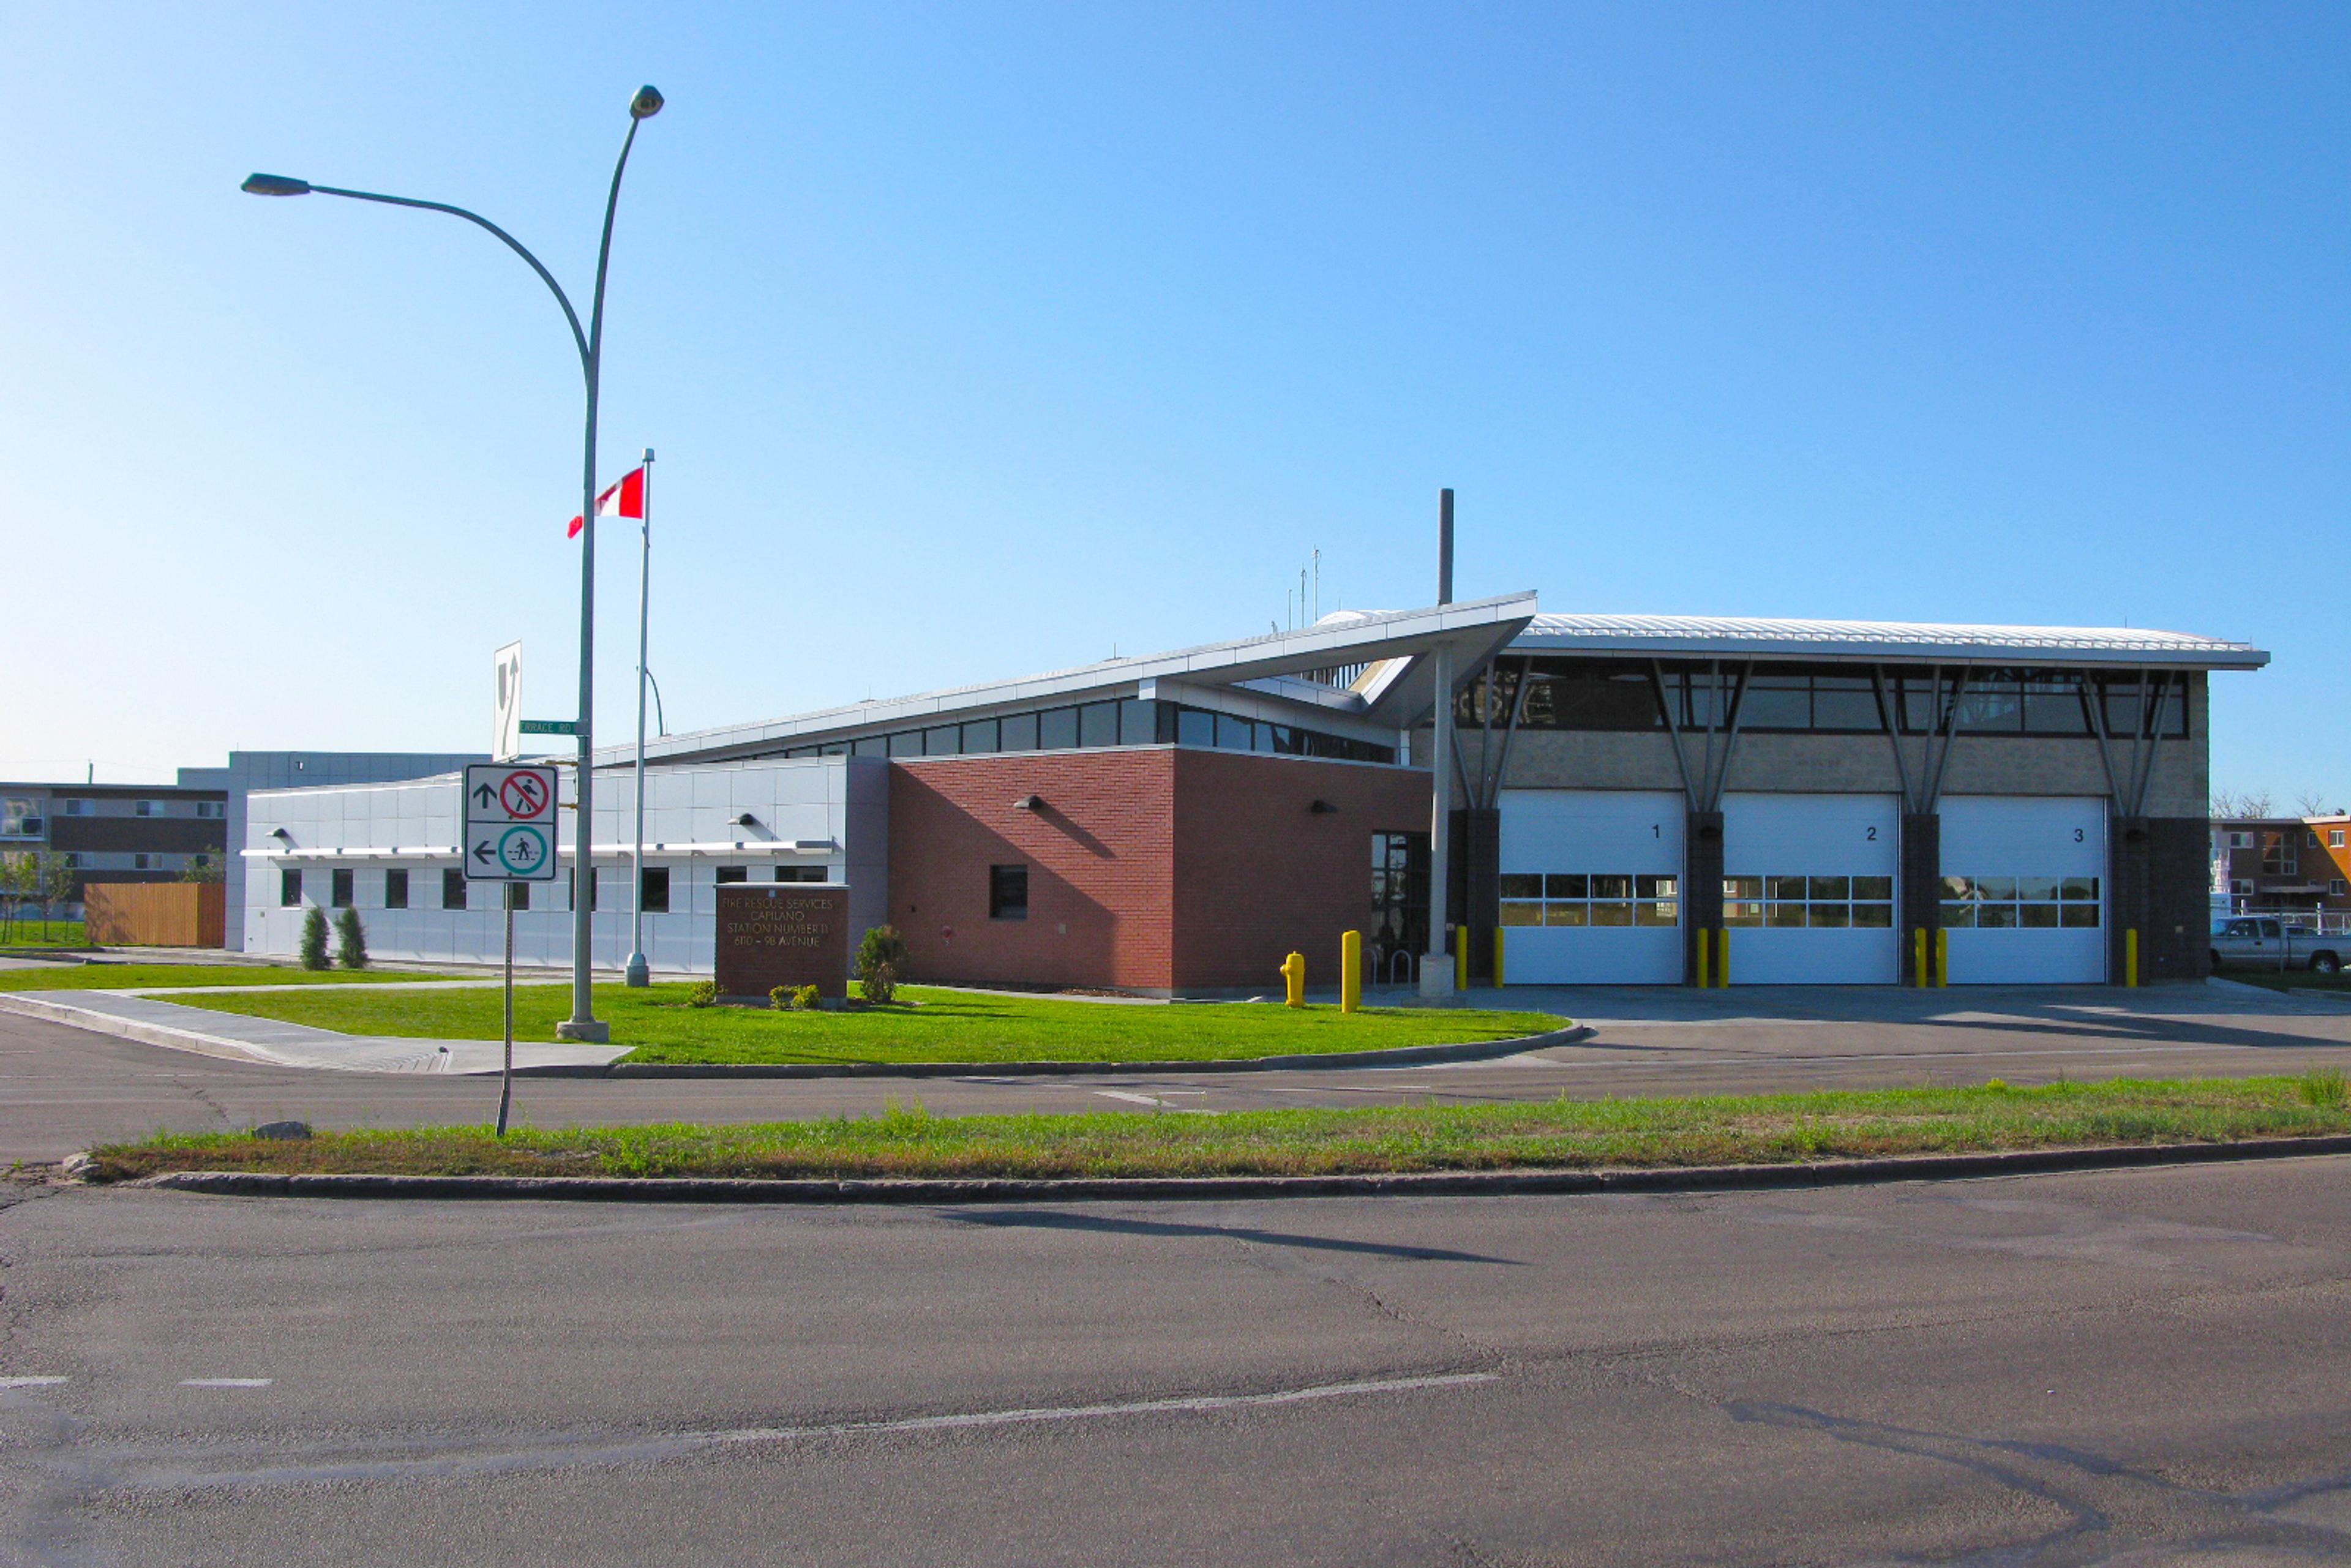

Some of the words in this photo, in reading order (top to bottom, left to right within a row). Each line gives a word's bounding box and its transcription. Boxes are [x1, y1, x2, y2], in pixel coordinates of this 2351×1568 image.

[520, 721, 553, 733] ERRACE
[558, 722, 571, 733] RD
[1652, 824, 1659, 838] 1
[1867, 827, 1877, 841] 2
[2074, 828, 2083, 842] 3
[722, 898, 741, 908] FIRE
[744, 898, 784, 909] RESCUE
[786, 899, 833, 910] SERVICES
[751, 911, 805, 921] CAPILANO
[727, 923, 771, 934] STATION
[774, 924, 818, 934] NUMBER
[734, 936, 753, 946] 6110
[778, 936, 821, 947] AVENUE
